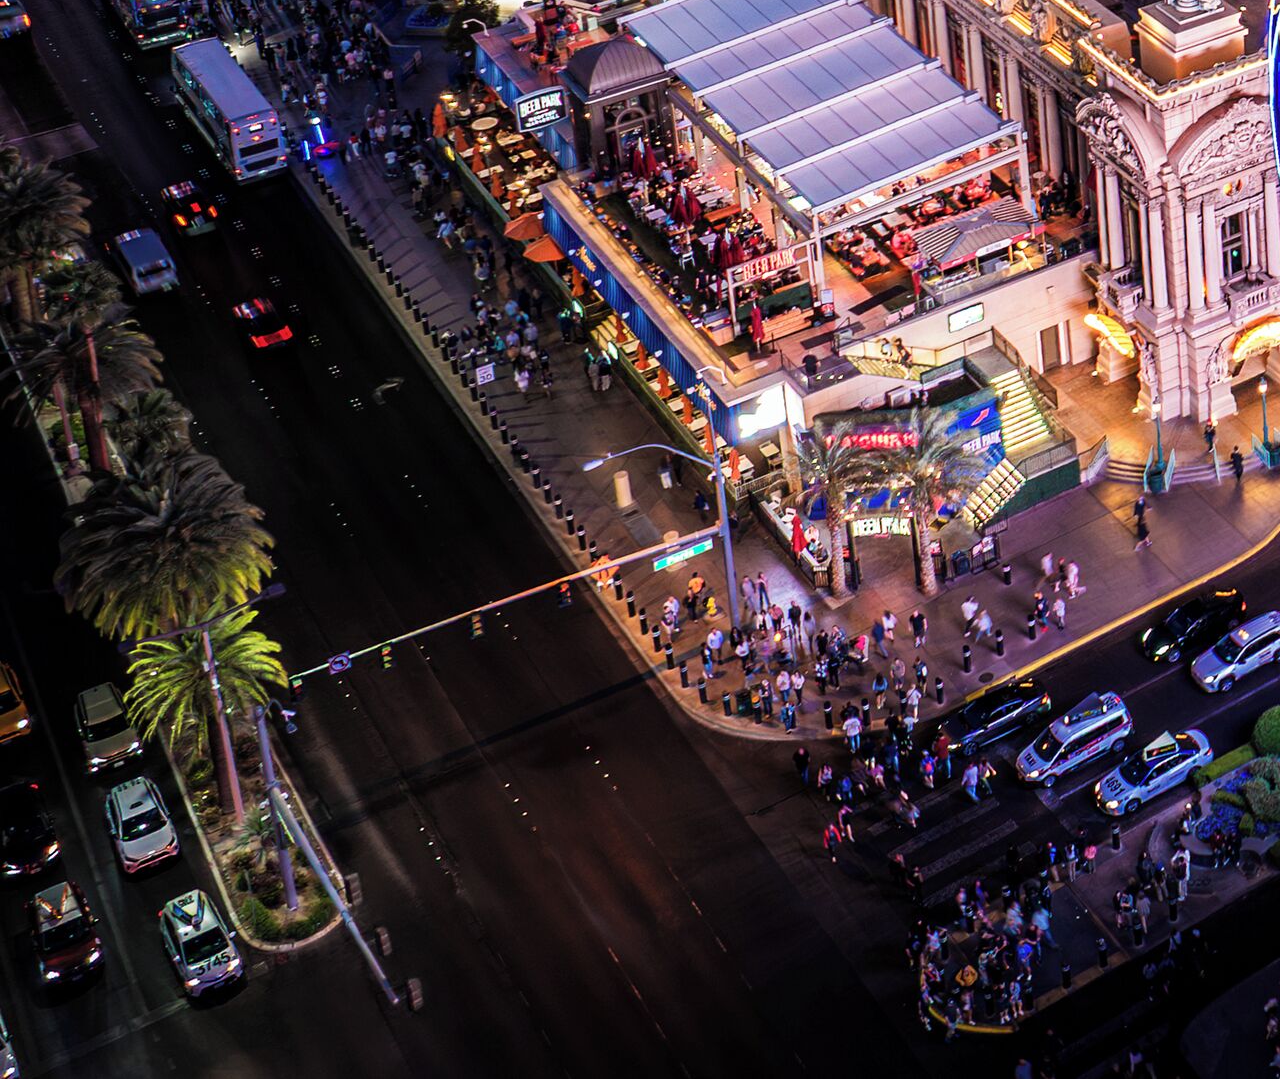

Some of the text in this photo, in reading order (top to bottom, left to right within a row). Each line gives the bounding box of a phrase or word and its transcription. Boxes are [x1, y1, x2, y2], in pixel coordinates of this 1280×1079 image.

[520, 92, 563, 118] BEER PARK
[743, 248, 796, 282] BEER PARK
[1104, 775, 1126, 798] 4691
